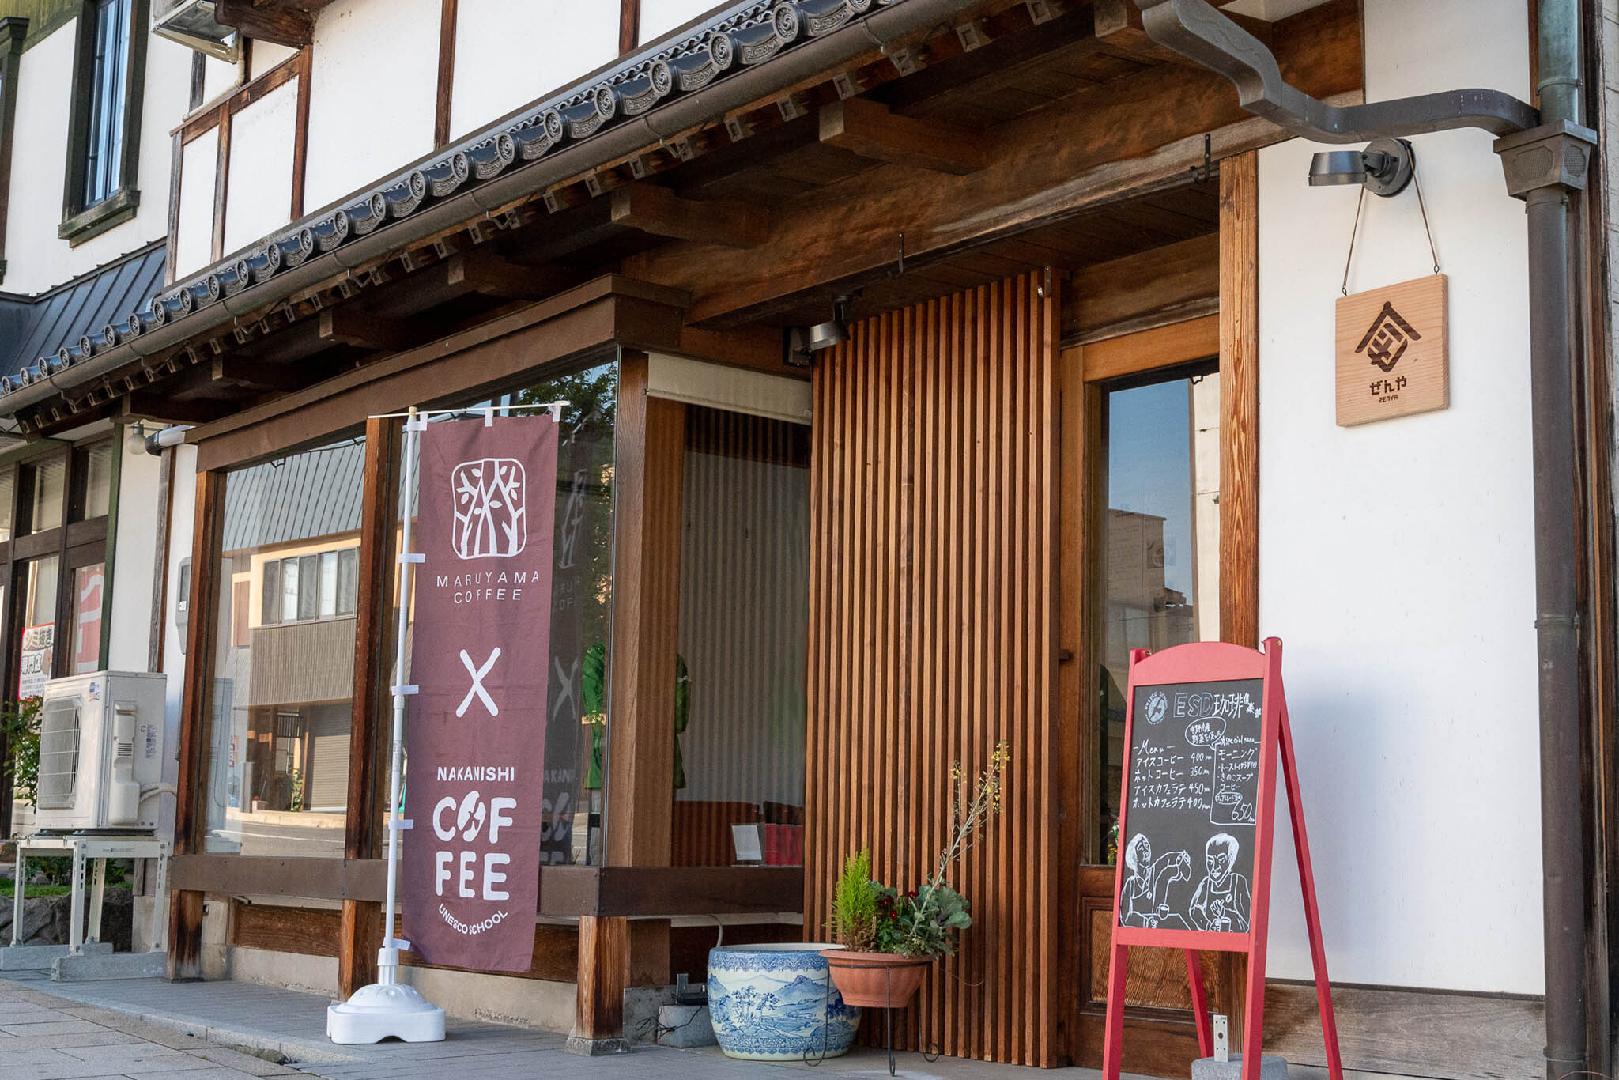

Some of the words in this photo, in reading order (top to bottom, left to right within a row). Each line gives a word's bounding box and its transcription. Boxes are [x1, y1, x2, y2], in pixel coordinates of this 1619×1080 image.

[1370, 376, 1407, 396] ぜんや
[436, 571, 540, 588] MARUYAMA
[454, 589, 523, 604] COFFEE
[1136, 755, 1184, 768] アイスコーヒー
[437, 766, 515, 781] NAKANISHI
[435, 851, 511, 901] FEE
[438, 903, 468, 934] UNESCO
[469, 910, 509, 935] SCHOOL
